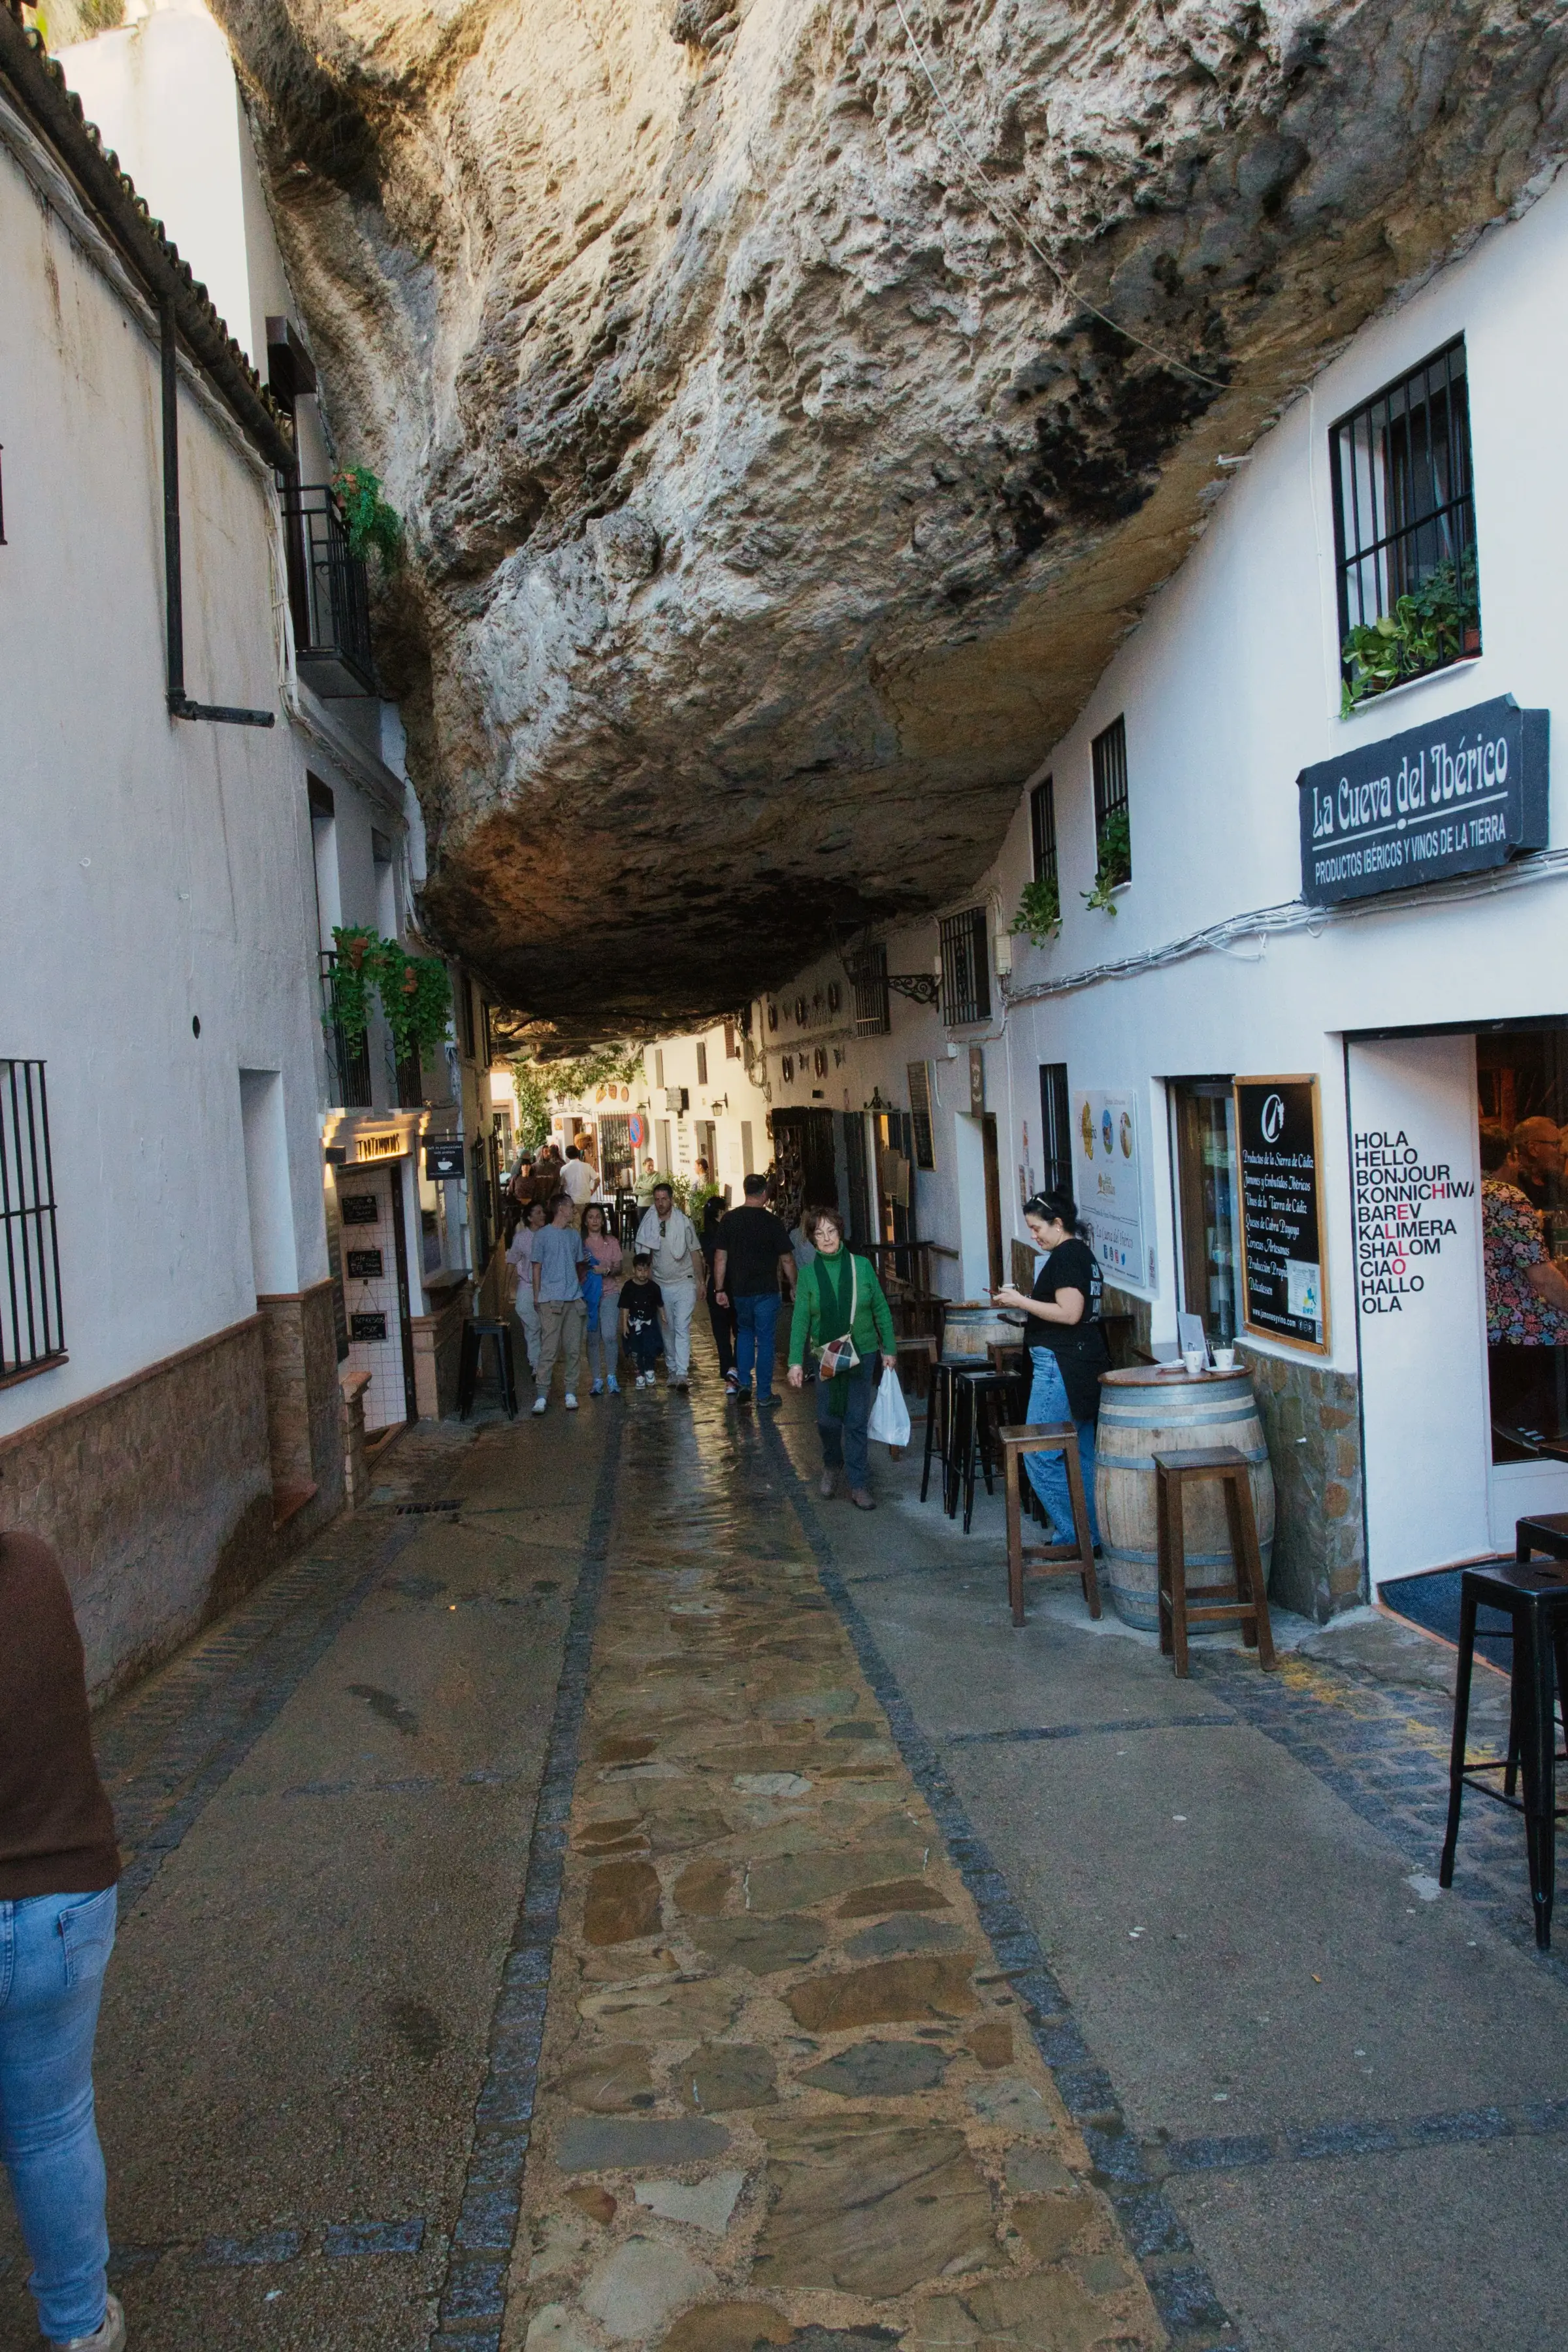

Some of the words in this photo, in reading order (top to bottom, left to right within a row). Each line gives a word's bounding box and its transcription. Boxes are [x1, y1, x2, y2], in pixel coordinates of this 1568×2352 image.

[1313, 787, 1333, 838] La
[1338, 776, 1392, 830] Cueva
[1397, 751, 1426, 813] del
[1431, 733, 1509, 804] Ibérico
[1315, 855, 1362, 885] PRODUCTOS
[1364, 841, 1402, 874] IBÉRICOS
[1403, 839, 1410, 863] Y
[1411, 832, 1438, 860] VINOS
[1440, 828, 1453, 853] DE
[1456, 825, 1469, 849] LA
[1469, 813, 1506, 847] TIERRA
[1355, 1131, 1409, 1149] HOLA
[1243, 1149, 1264, 1164] Productos
[1264, 1151, 1269, 1165] de
[1269, 1152, 1274, 1165] la
[1275, 1152, 1291, 1166] Sierra
[1292, 1153, 1298, 1167] de
[1298, 1153, 1314, 1168] Cádiz
[1356, 1148, 1418, 1168] HELLO
[1243, 1170, 1260, 1188] Jamones
[1261, 1178, 1264, 1191] y
[1264, 1173, 1288, 1189] Embutidos
[1288, 1175, 1311, 1191] Ibéricos
[1356, 1164, 1450, 1186] BONJOUR
[1258, 1194, 1262, 1207] de
[1263, 1195, 1267, 1208] la
[1268, 1195, 1285, 1211] Tierra
[1286, 1198, 1291, 1211] de
[1292, 1198, 1307, 1214] Cádiz
[1358, 1203, 1422, 1222] BAREV
[1245, 1213, 1260, 1231] Quesos
[1260, 1217, 1265, 1229] de
[1265, 1217, 1279, 1232] Cabra
[1279, 1218, 1299, 1240] Payoya
[1359, 1218, 1457, 1241] KALIMERA
[1360, 1238, 1441, 1260] SHALOM
[1247, 1255, 1270, 1273] Producción
[1360, 1258, 1406, 1278] CIAO
[1362, 1275, 1424, 1296] HALLO
[1362, 1296, 1403, 1315] OLA
